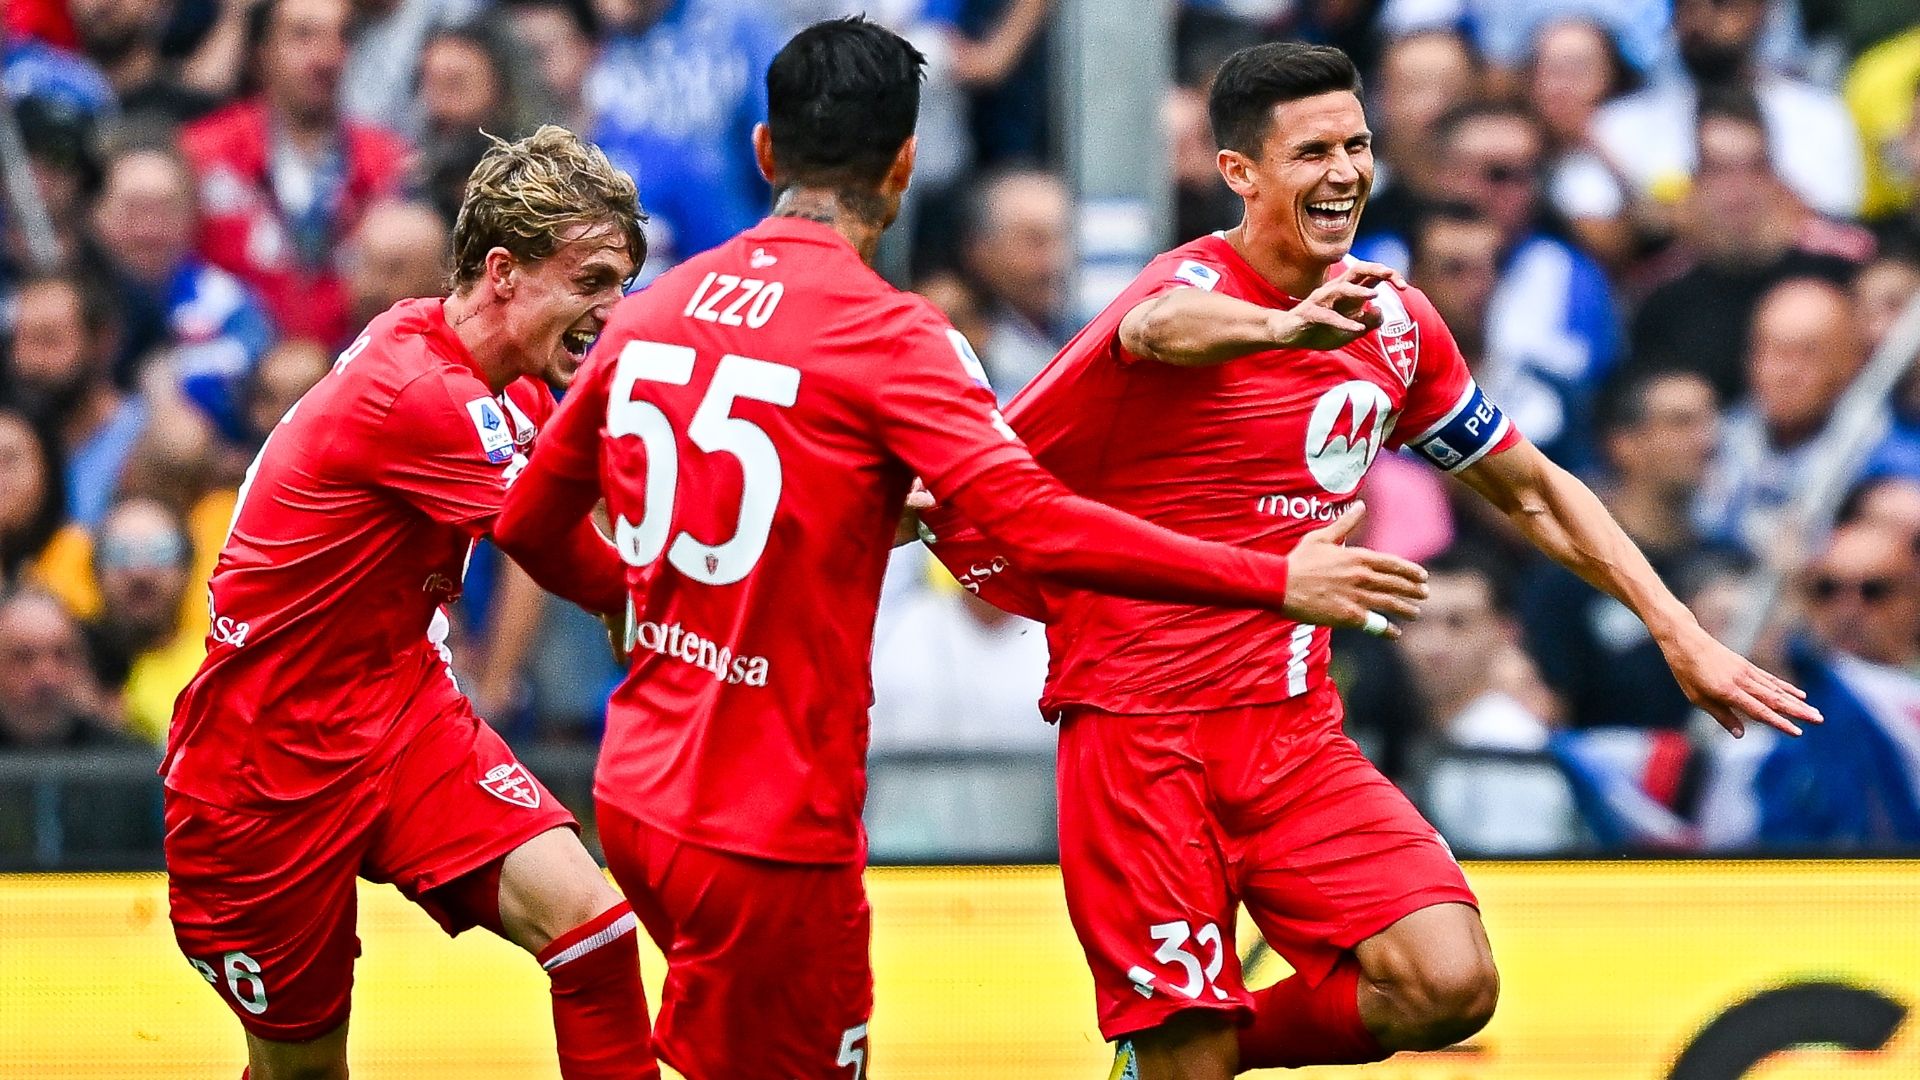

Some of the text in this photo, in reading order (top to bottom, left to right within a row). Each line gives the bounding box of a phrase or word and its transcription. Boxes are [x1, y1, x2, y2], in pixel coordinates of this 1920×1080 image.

[683, 271, 785, 330] IZZO
[607, 339, 801, 586] 55
[1257, 495, 1352, 521] moto
[1150, 920, 1229, 1000] 32
